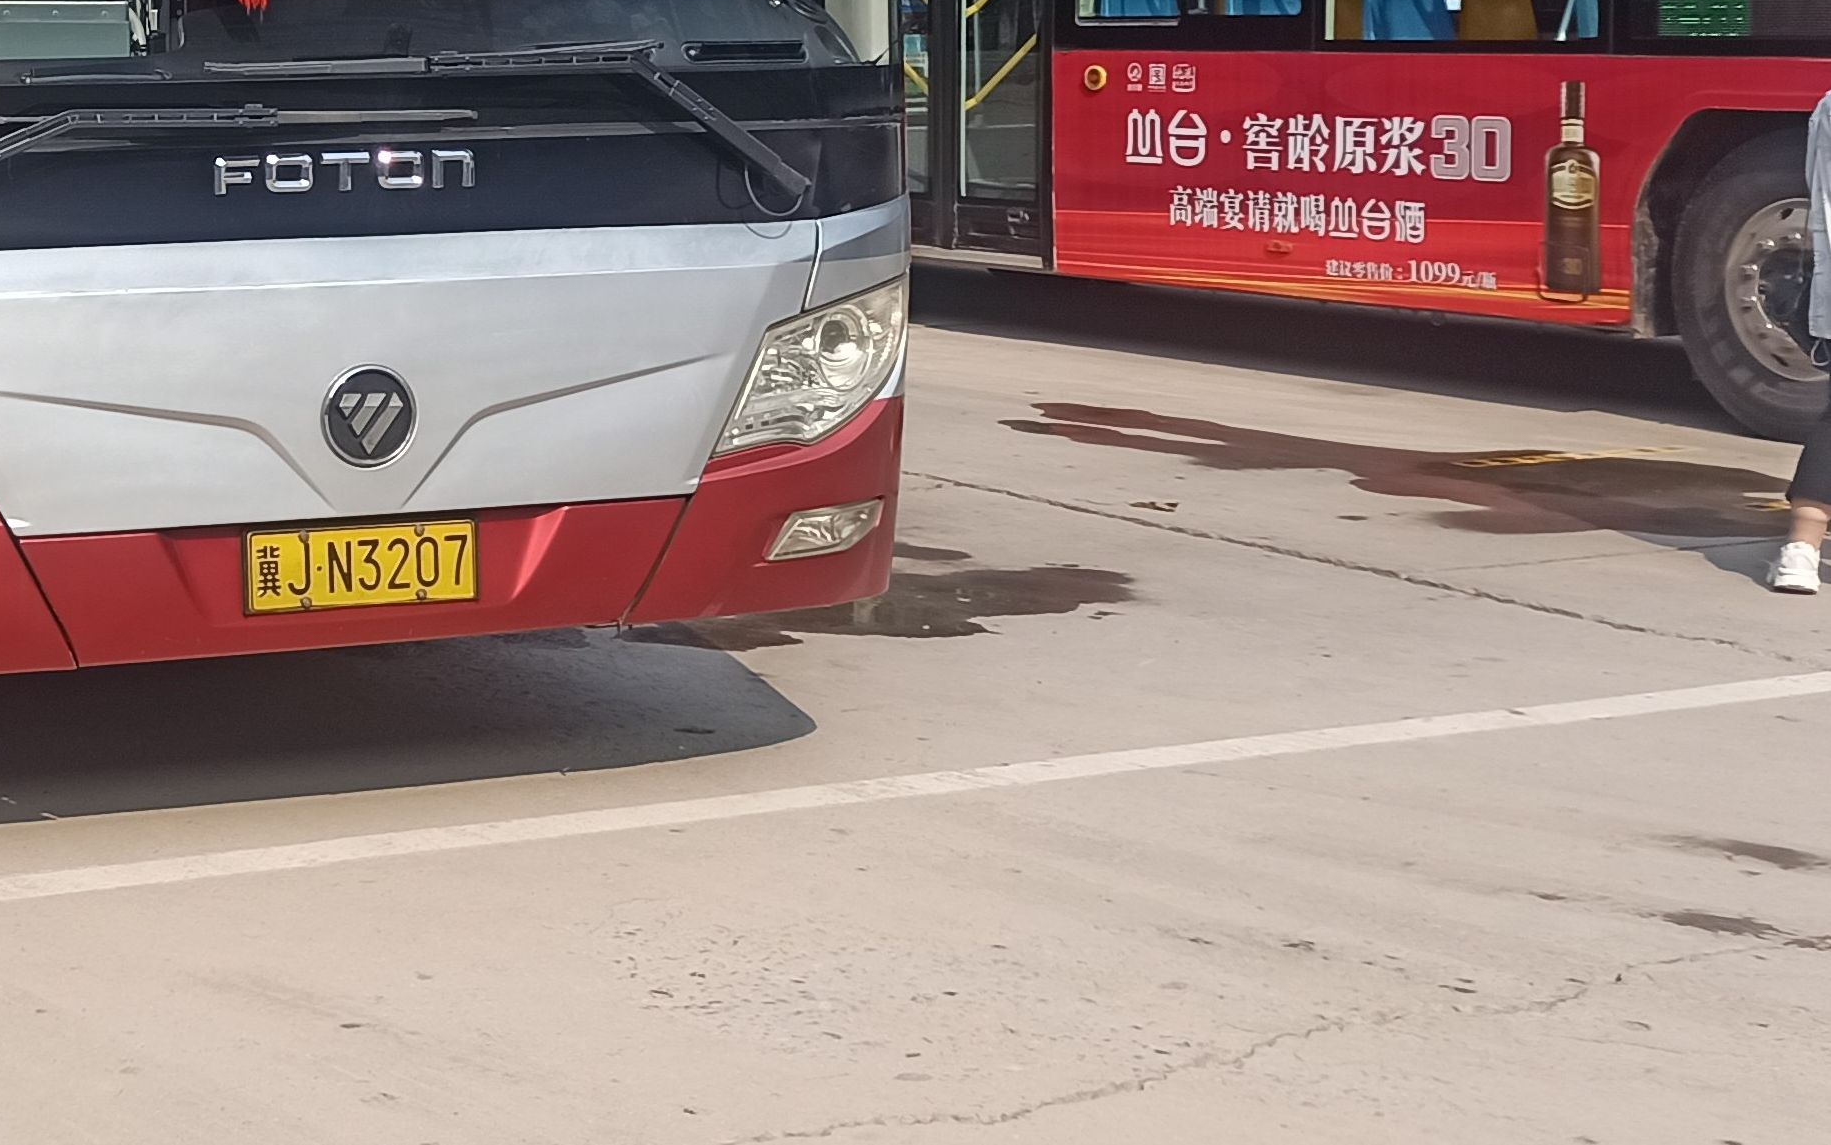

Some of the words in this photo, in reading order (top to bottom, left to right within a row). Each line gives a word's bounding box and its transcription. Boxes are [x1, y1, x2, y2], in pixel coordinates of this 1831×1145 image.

[213, 149, 476, 196] FOTON
[1168, 184, 1427, 245] 高端宴请就喝丛台酒
[255, 534, 469, 598] 冀J·N3207
